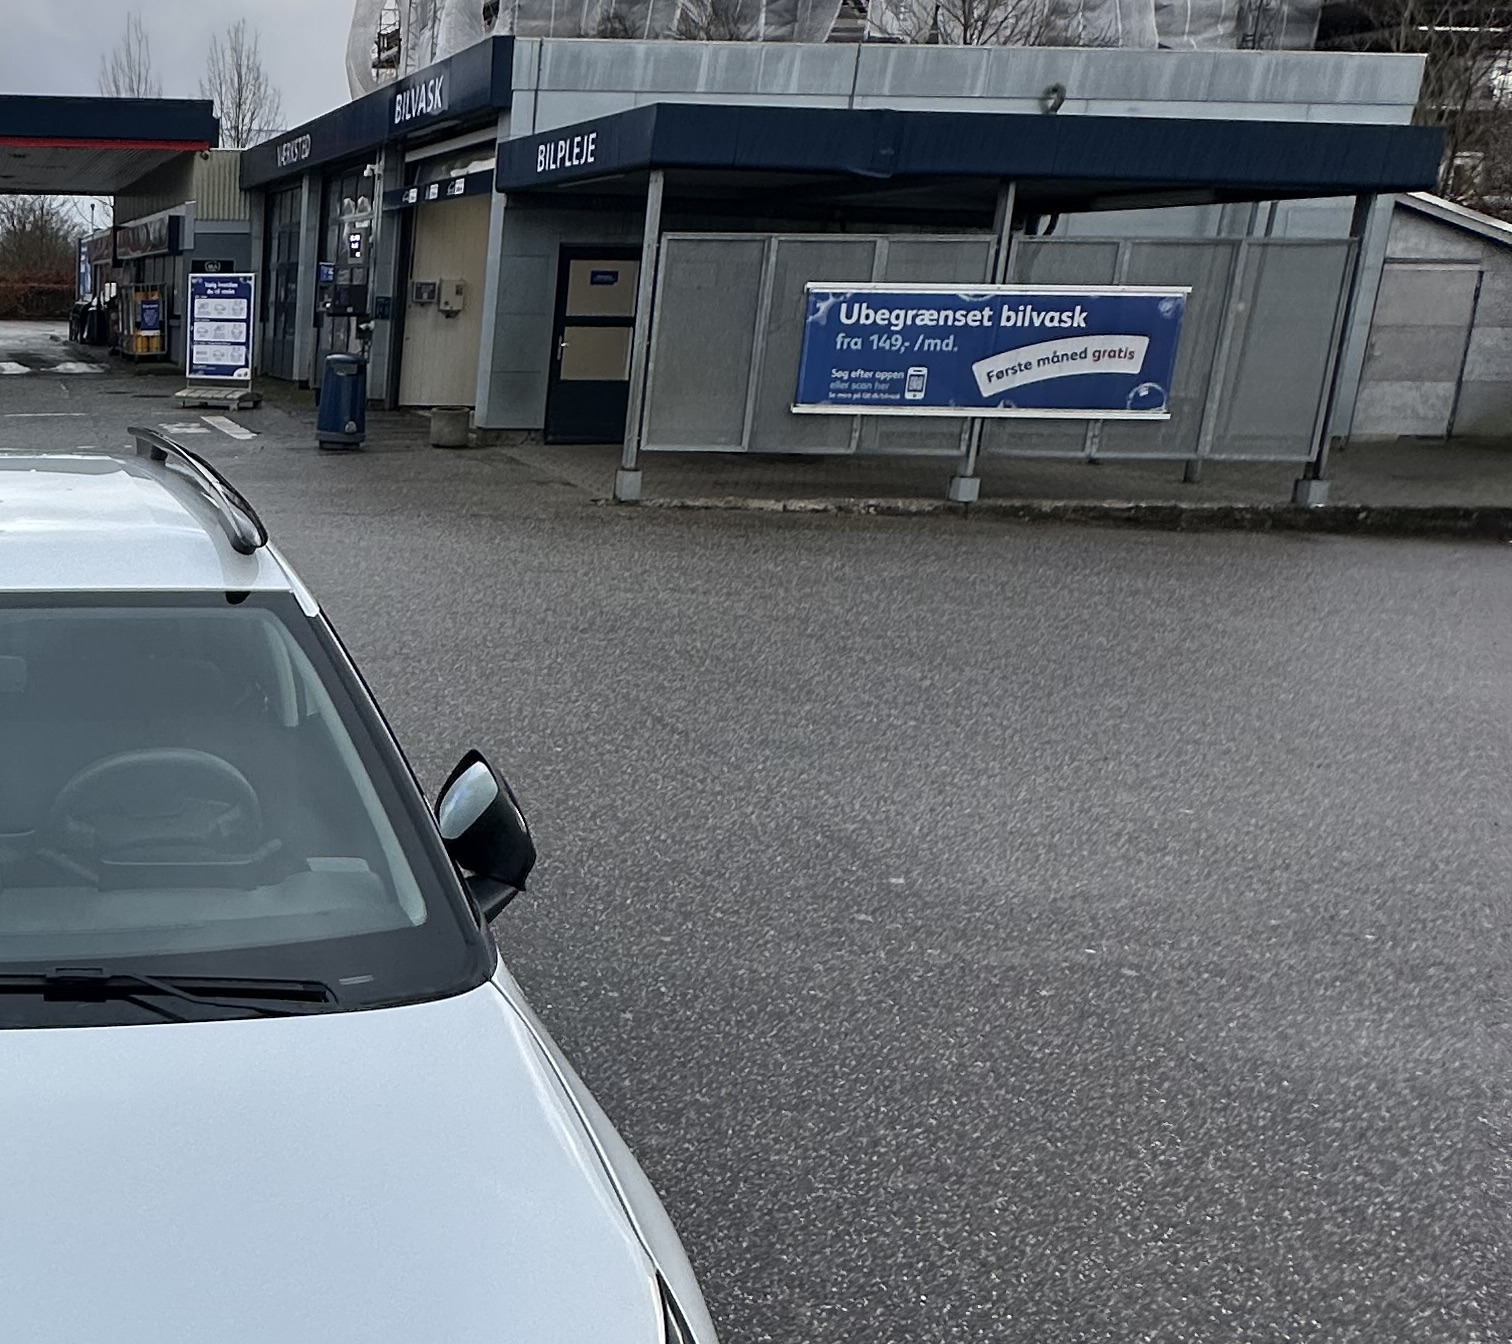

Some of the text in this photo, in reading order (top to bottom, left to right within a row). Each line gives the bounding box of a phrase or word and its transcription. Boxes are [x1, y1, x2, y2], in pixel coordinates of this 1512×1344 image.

[394, 74, 445, 124] BILVASK
[537, 132, 597, 172] BILPLEJE
[839, 302, 1088, 330] Ubegrænset bilvask
[836, 332, 958, 354] fra 149,- /md.
[850, 368, 874, 379] efter
[874, 370, 905, 380] appen
[986, 347, 1136, 383] Første måned gratis
[851, 382, 872, 390] scan
[874, 381, 890, 390] her
